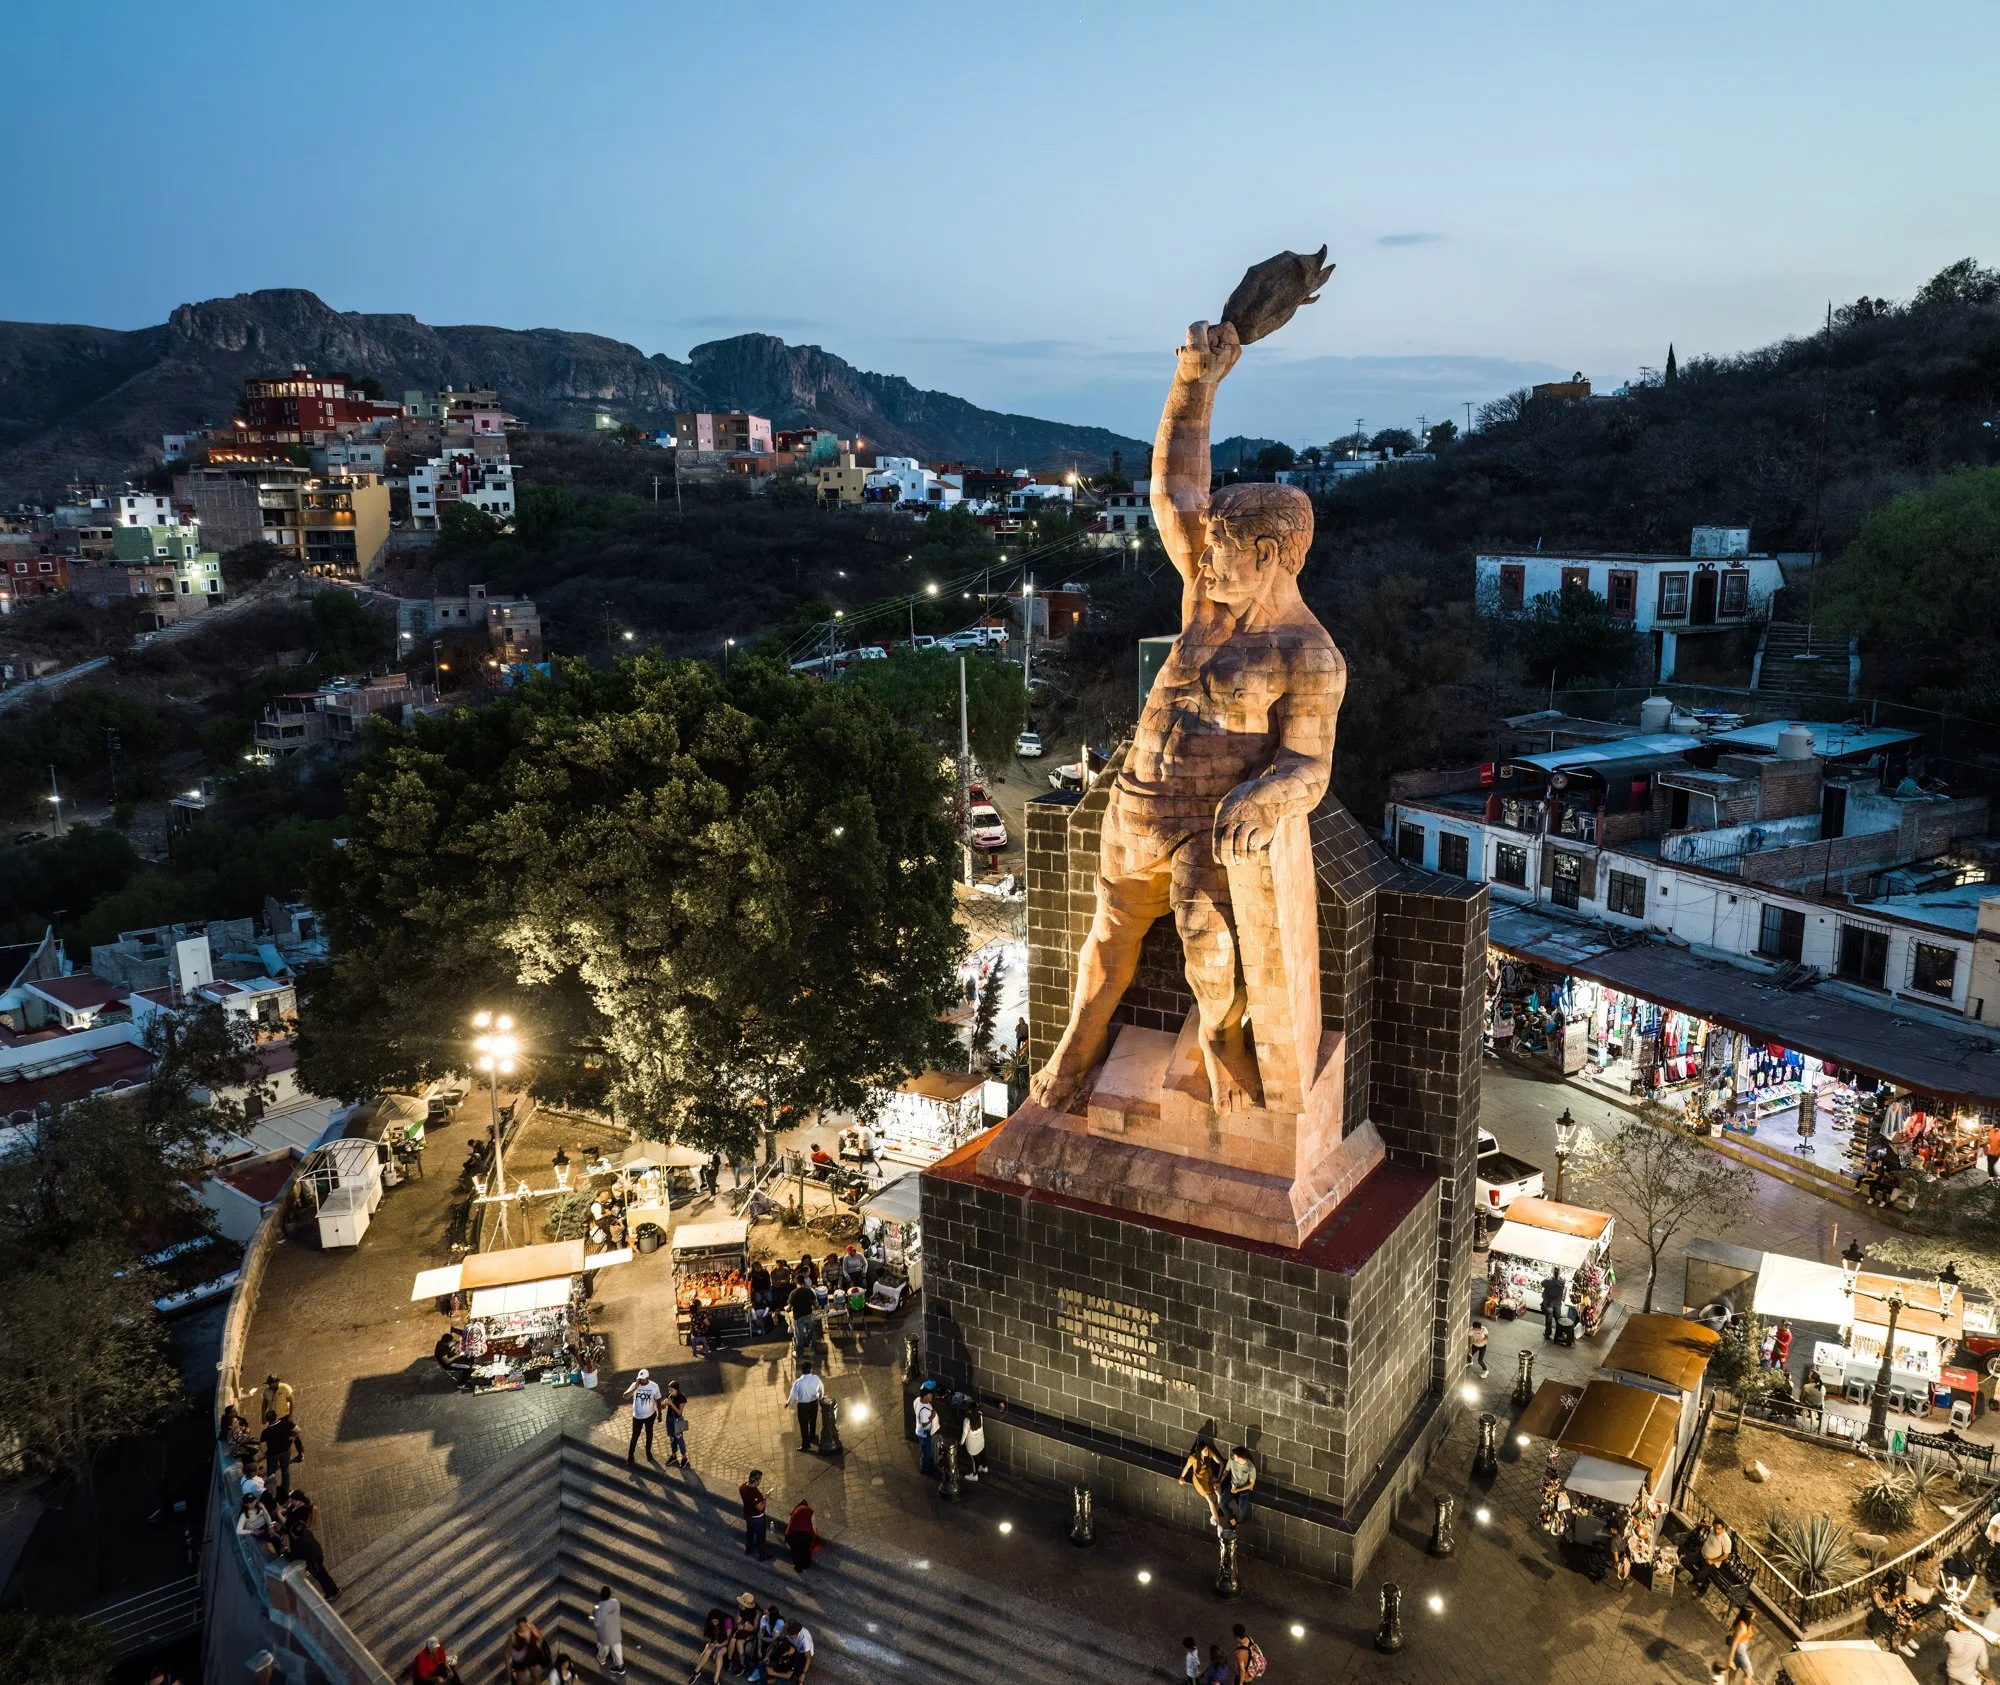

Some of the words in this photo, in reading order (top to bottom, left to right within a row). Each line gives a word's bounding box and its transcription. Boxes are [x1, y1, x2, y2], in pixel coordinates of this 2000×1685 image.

[1087, 1293, 1111, 1311] HAY
[1114, 1302, 1160, 1325] OTRAS
[1056, 1315, 1083, 1334] POR
[1072, 1336, 1148, 1367] GUANAJUATO
[636, 1393, 651, 1402] FOX
